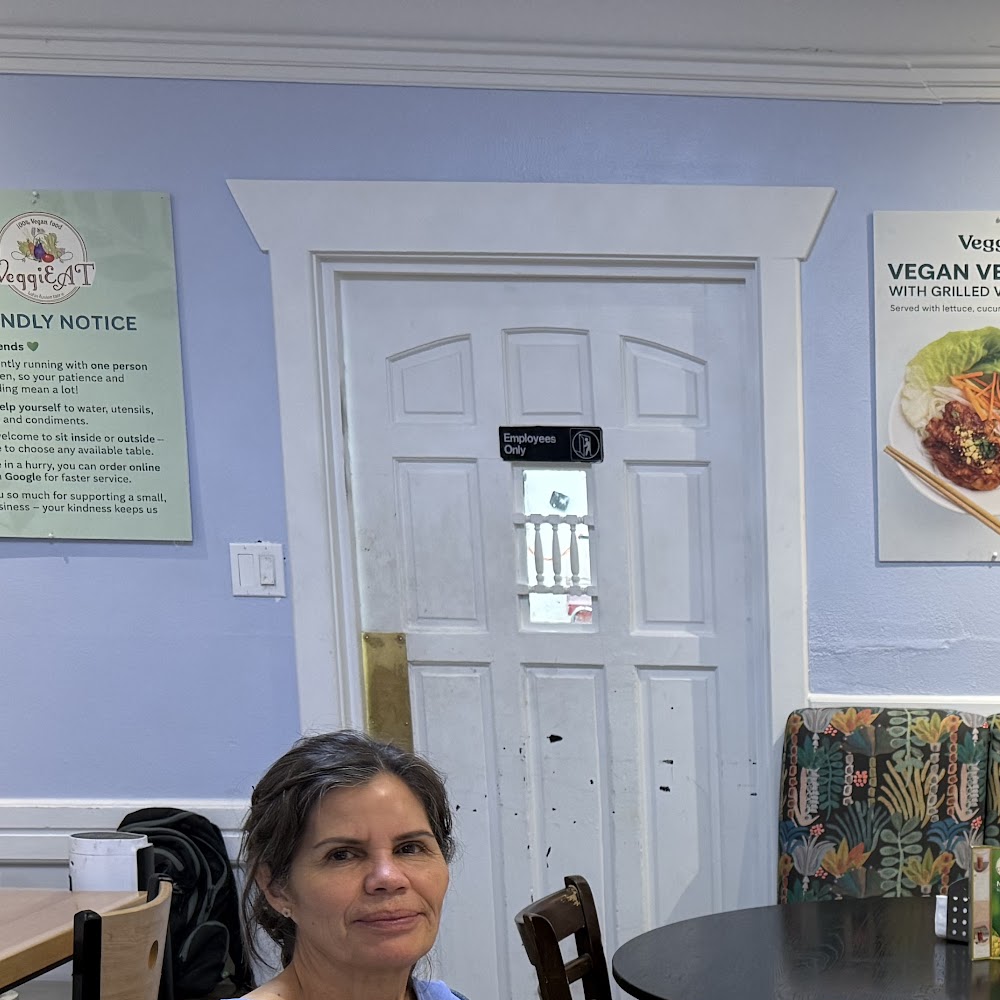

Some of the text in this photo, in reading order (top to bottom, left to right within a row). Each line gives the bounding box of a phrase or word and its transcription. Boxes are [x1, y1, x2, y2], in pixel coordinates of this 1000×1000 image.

[887, 263, 969, 280] VEGAN
[889, 286, 926, 297] WITH
[931, 286, 990, 297] GRILLED
[890, 304, 920, 312] Served
[942, 304, 975, 313] lettuce,
[60, 315, 137, 331] NOTICE
[23, 360, 63, 371] running
[65, 360, 88, 370] with
[113, 363, 148, 372] person
[32, 374, 56, 383] your
[58, 373, 103, 383] patience
[105, 374, 124, 383] and
[3, 415, 88, 425] and condiments.
[503, 433, 556, 444] Employees
[504, 444, 526, 456] Only
[4, 459, 14, 469] in
[25, 460, 55, 472] hurry,
[57, 463, 75, 472] you
[99, 462, 126, 471] order
[129, 463, 160, 472] online
